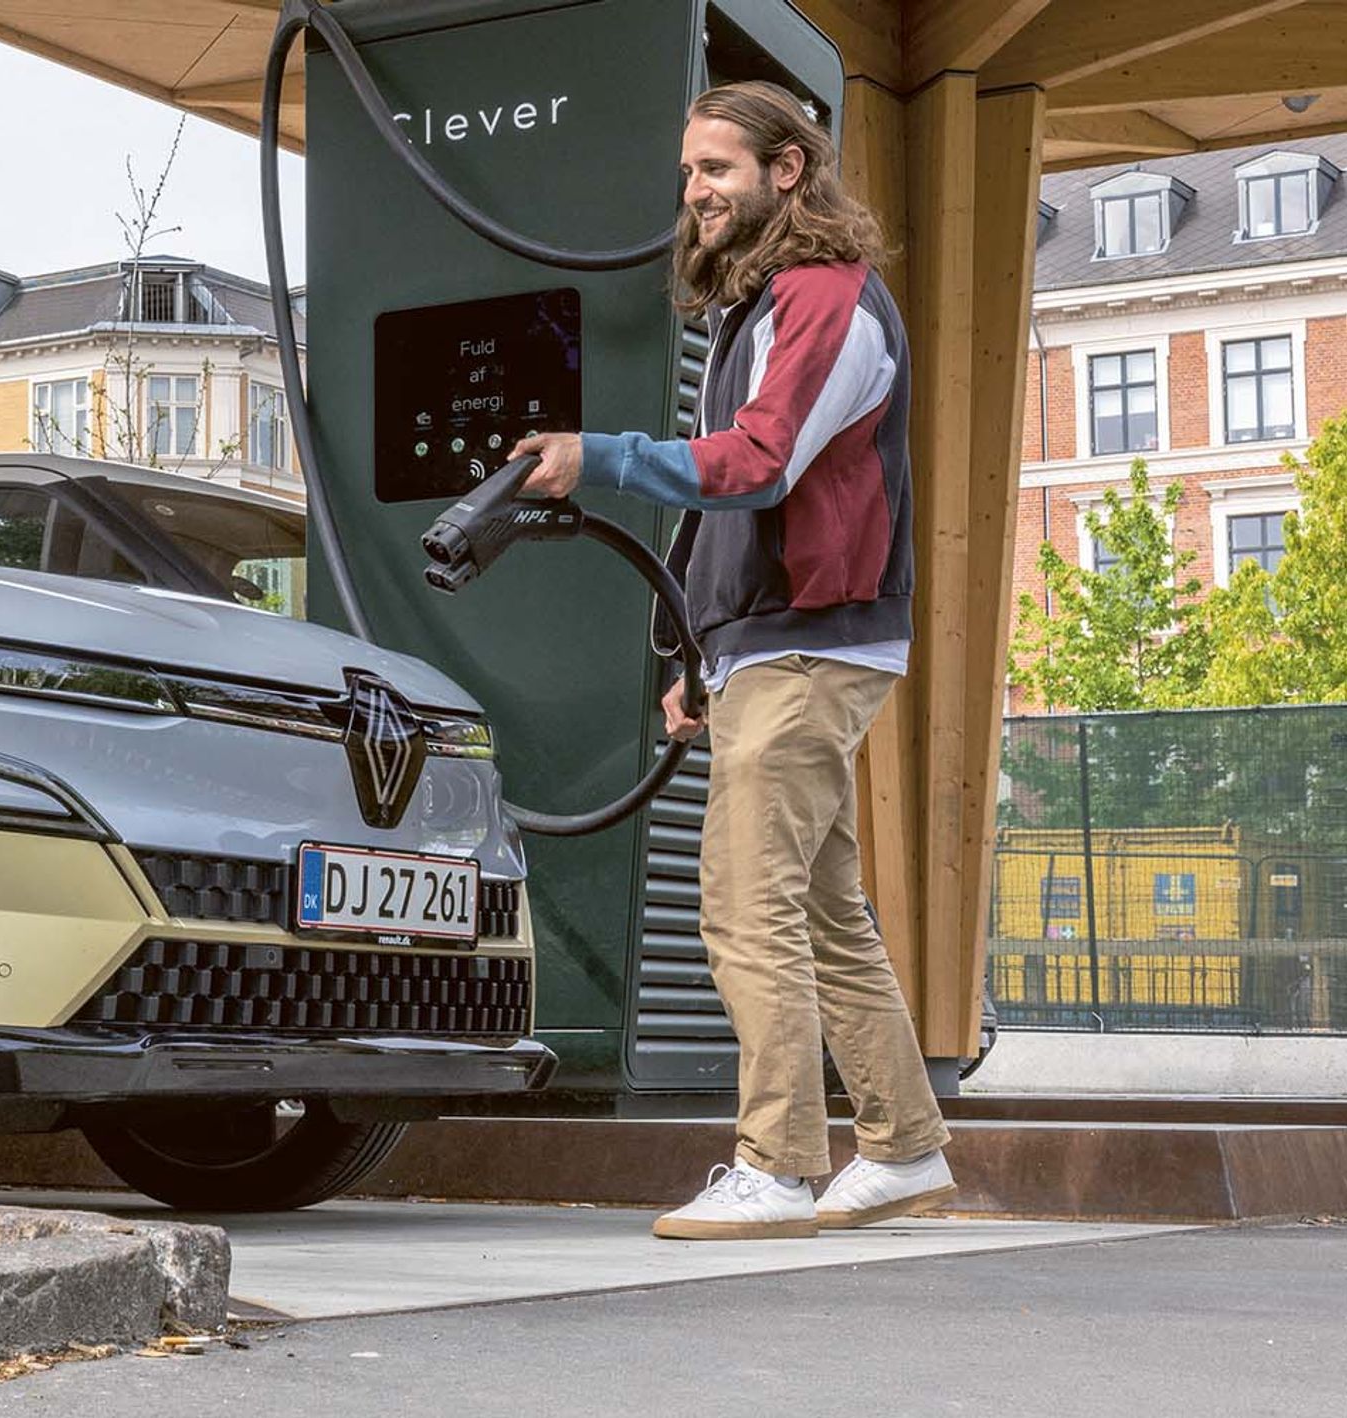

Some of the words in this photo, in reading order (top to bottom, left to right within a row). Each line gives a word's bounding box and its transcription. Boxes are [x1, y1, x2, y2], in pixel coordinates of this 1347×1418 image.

[460, 339, 495, 356] Fuld
[469, 366, 487, 383] af
[452, 391, 503, 411] energi
[304, 893, 318, 909] DK
[326, 862, 369, 916] DJ
[378, 867, 415, 919] 27
[423, 870, 469, 923] 261
